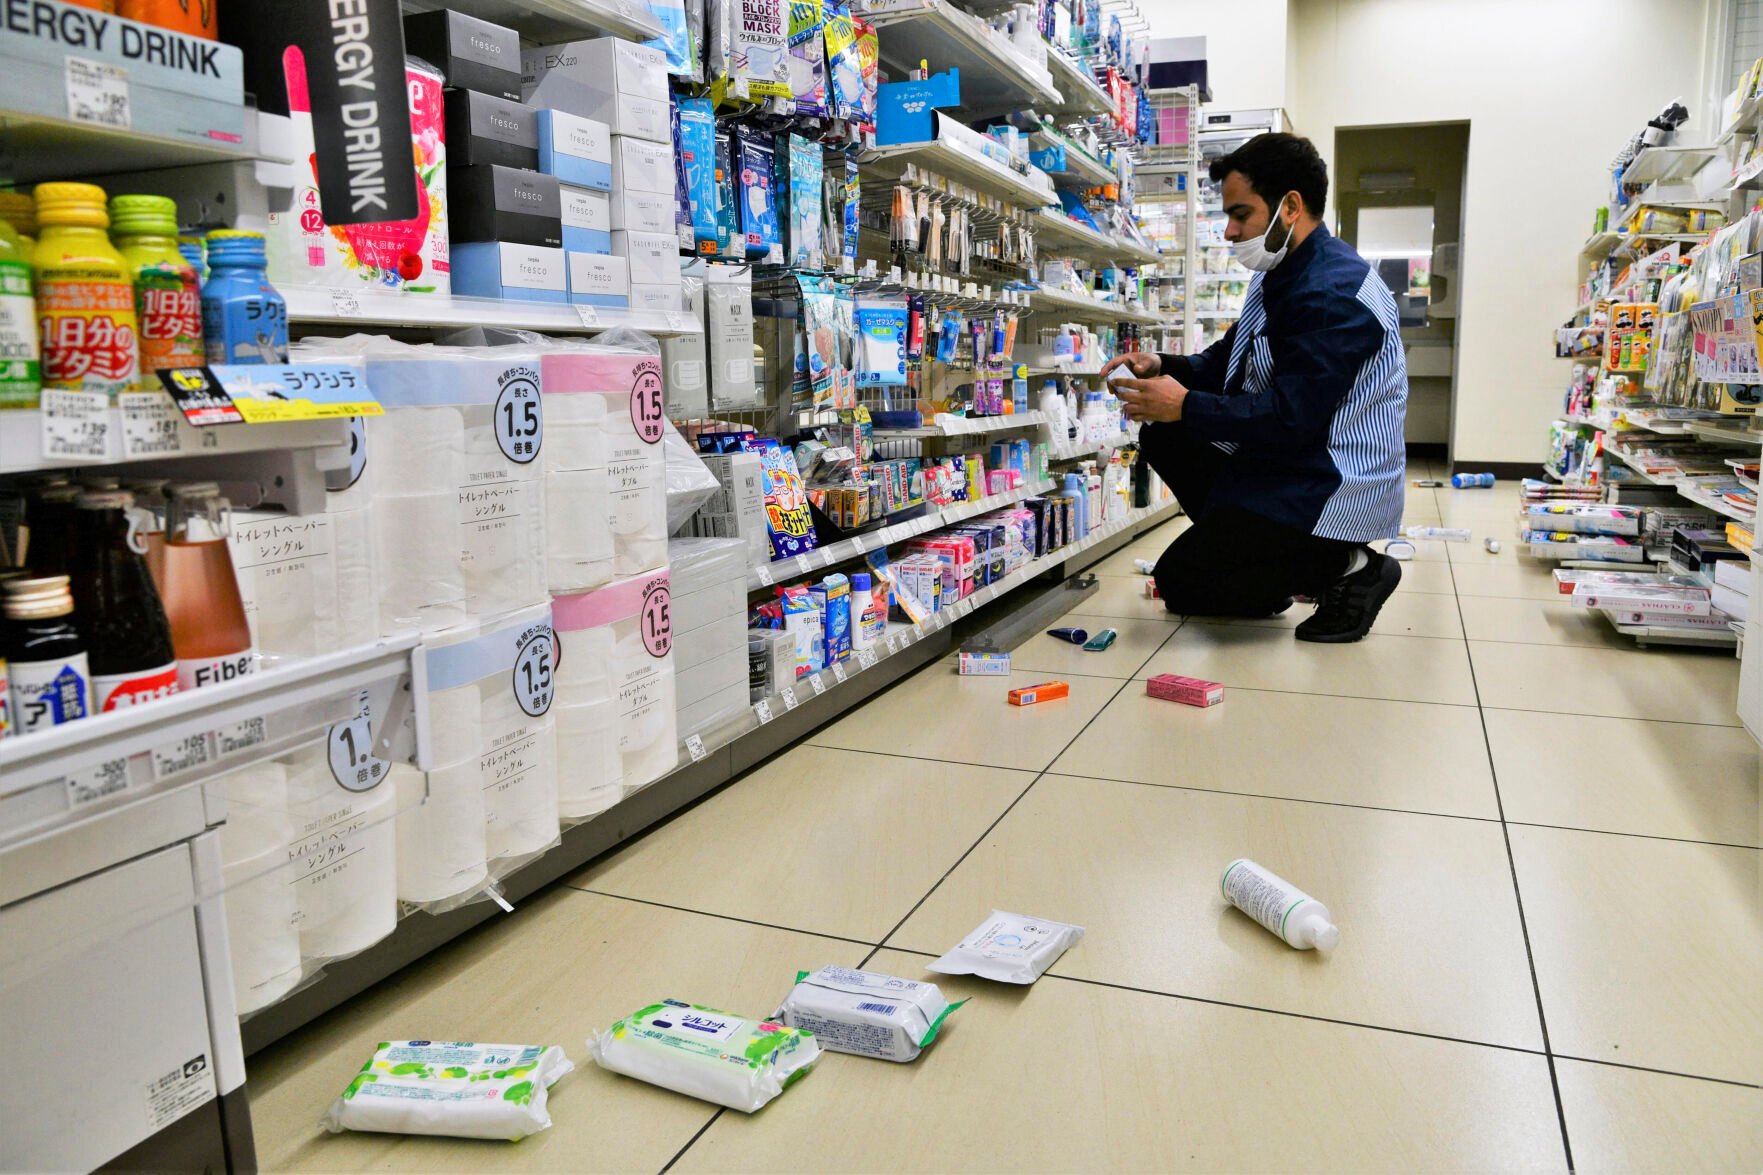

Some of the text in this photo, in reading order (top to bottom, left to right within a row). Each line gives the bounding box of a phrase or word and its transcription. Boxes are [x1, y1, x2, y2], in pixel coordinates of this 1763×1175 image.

[743, 2, 779, 17] BLOCK
[744, 21, 780, 35] MASK
[0, 0, 108, 51] ERGY
[121, 26, 221, 79] DRINK
[471, 36, 500, 54] fresco
[490, 114, 519, 131] fresco
[570, 133, 595, 147] fresco
[341, 101, 387, 213] DRINK
[305, 190, 316, 205] 4
[514, 188, 543, 202] fresco
[569, 205, 594, 217] fresco
[303, 213, 322, 229] 12
[358, 222, 413, 234] レットロール
[519, 264, 547, 276] fresco
[587, 272, 612, 282] fresco
[143, 289, 200, 315] 1日分
[41, 315, 133, 348] 1日分の
[42, 350, 134, 379] ビタミン
[282, 371, 356, 390] ラクシテ
[514, 387, 529, 398] 長さ
[637, 390, 662, 421] 1.5
[503, 401, 538, 438] 1.5
[513, 441, 533, 455] 倍巻
[608, 464, 649, 476] トイレットペーパー
[622, 477, 637, 487] ダブル
[459, 487, 520, 503] トイレットペーパー
[475, 503, 506, 516] シングル
[236, 520, 327, 544] トイレットペーパー
[260, 540, 305, 558] シングル
[647, 604, 670, 638] 1.5
[515, 624, 552, 649] 長持ち・コンパク
[522, 653, 550, 695] 1.5
[619, 679, 660, 701] トイレットペーパー
[183, 733, 206, 749] 105
[481, 741, 535, 771] トイレットペーパー
[357, 762, 381, 784] 倍巻
[496, 759, 523, 778] シングル
[288, 821, 366, 862] トイレットペーパー
[308, 843, 346, 869] シングル
[682, 1013, 727, 1030] シルコット
